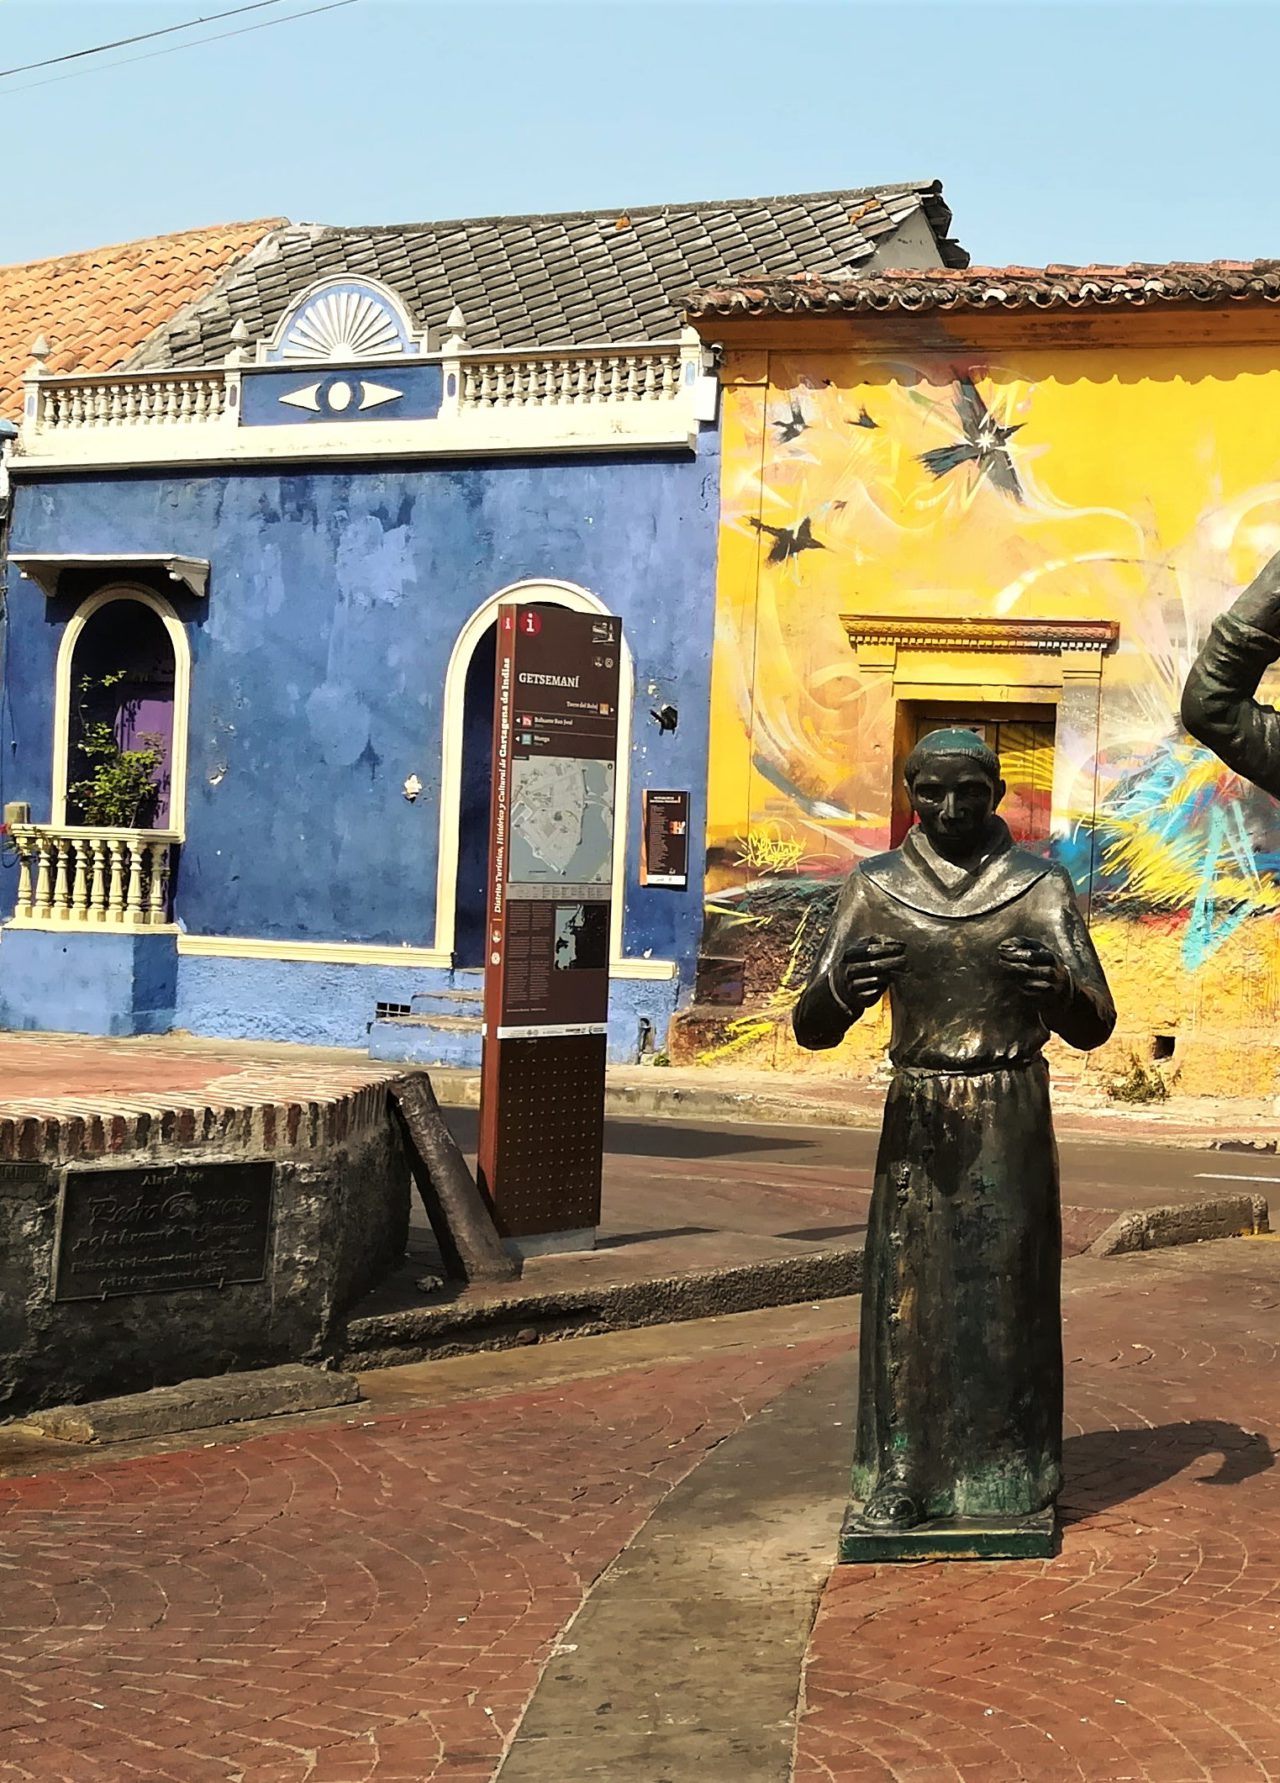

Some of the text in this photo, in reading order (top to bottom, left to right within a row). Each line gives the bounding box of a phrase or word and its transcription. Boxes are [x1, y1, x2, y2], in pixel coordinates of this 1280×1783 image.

[526, 612, 535, 633] i
[501, 657, 510, 690] Indias
[518, 673, 579, 688] GETSEMANÍ
[500, 691, 509, 704] de
[499, 705, 510, 758] Cartagena
[499, 758, 507, 768] de
[498, 769, 507, 802] Cultural
[496, 810, 505, 844] Histórico
[494, 883, 502, 913] Distrito
